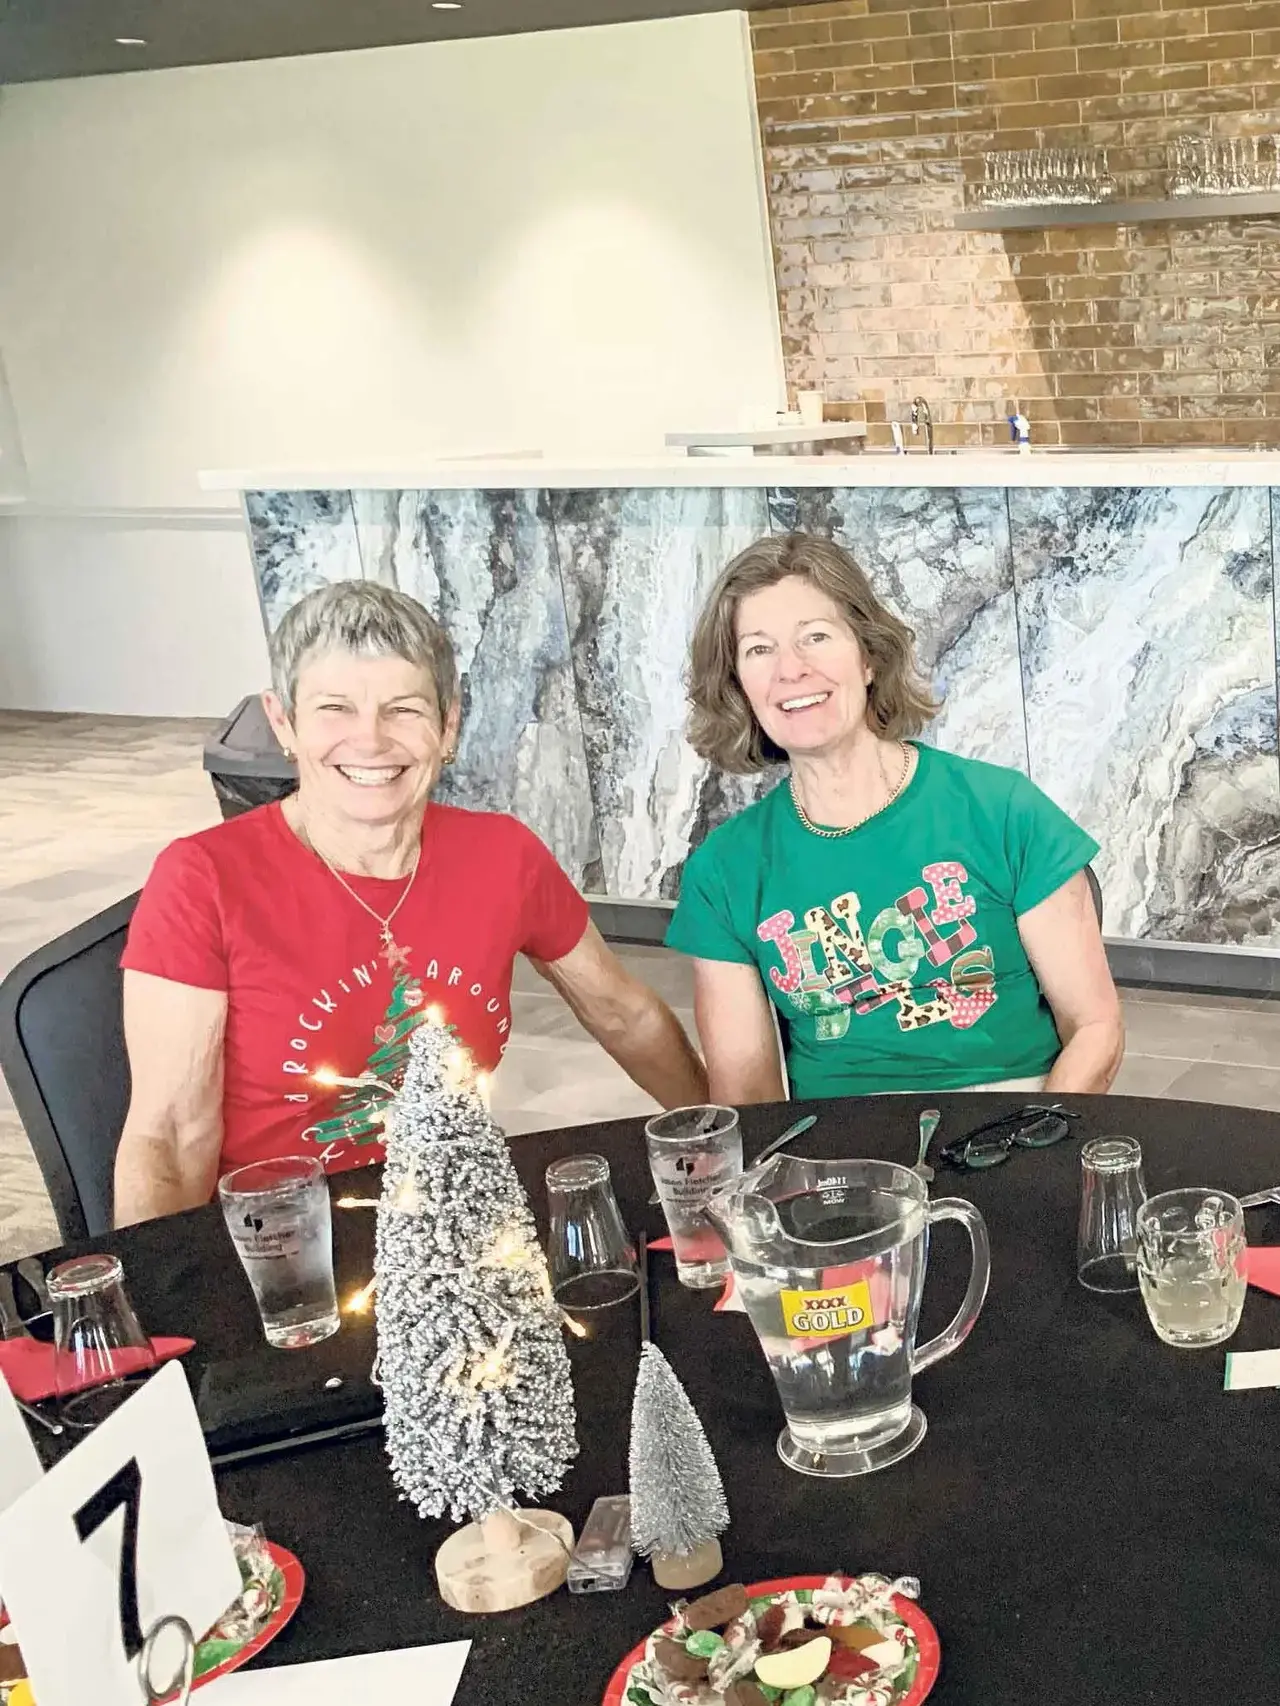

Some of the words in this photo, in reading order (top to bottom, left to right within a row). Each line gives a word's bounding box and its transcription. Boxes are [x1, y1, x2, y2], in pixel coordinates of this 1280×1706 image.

[757, 862, 987, 993] JINGLE
[792, 1307, 865, 1332] GOLD
[803, 1295, 847, 1311] XXXX
[72, 1456, 144, 1663] 7
